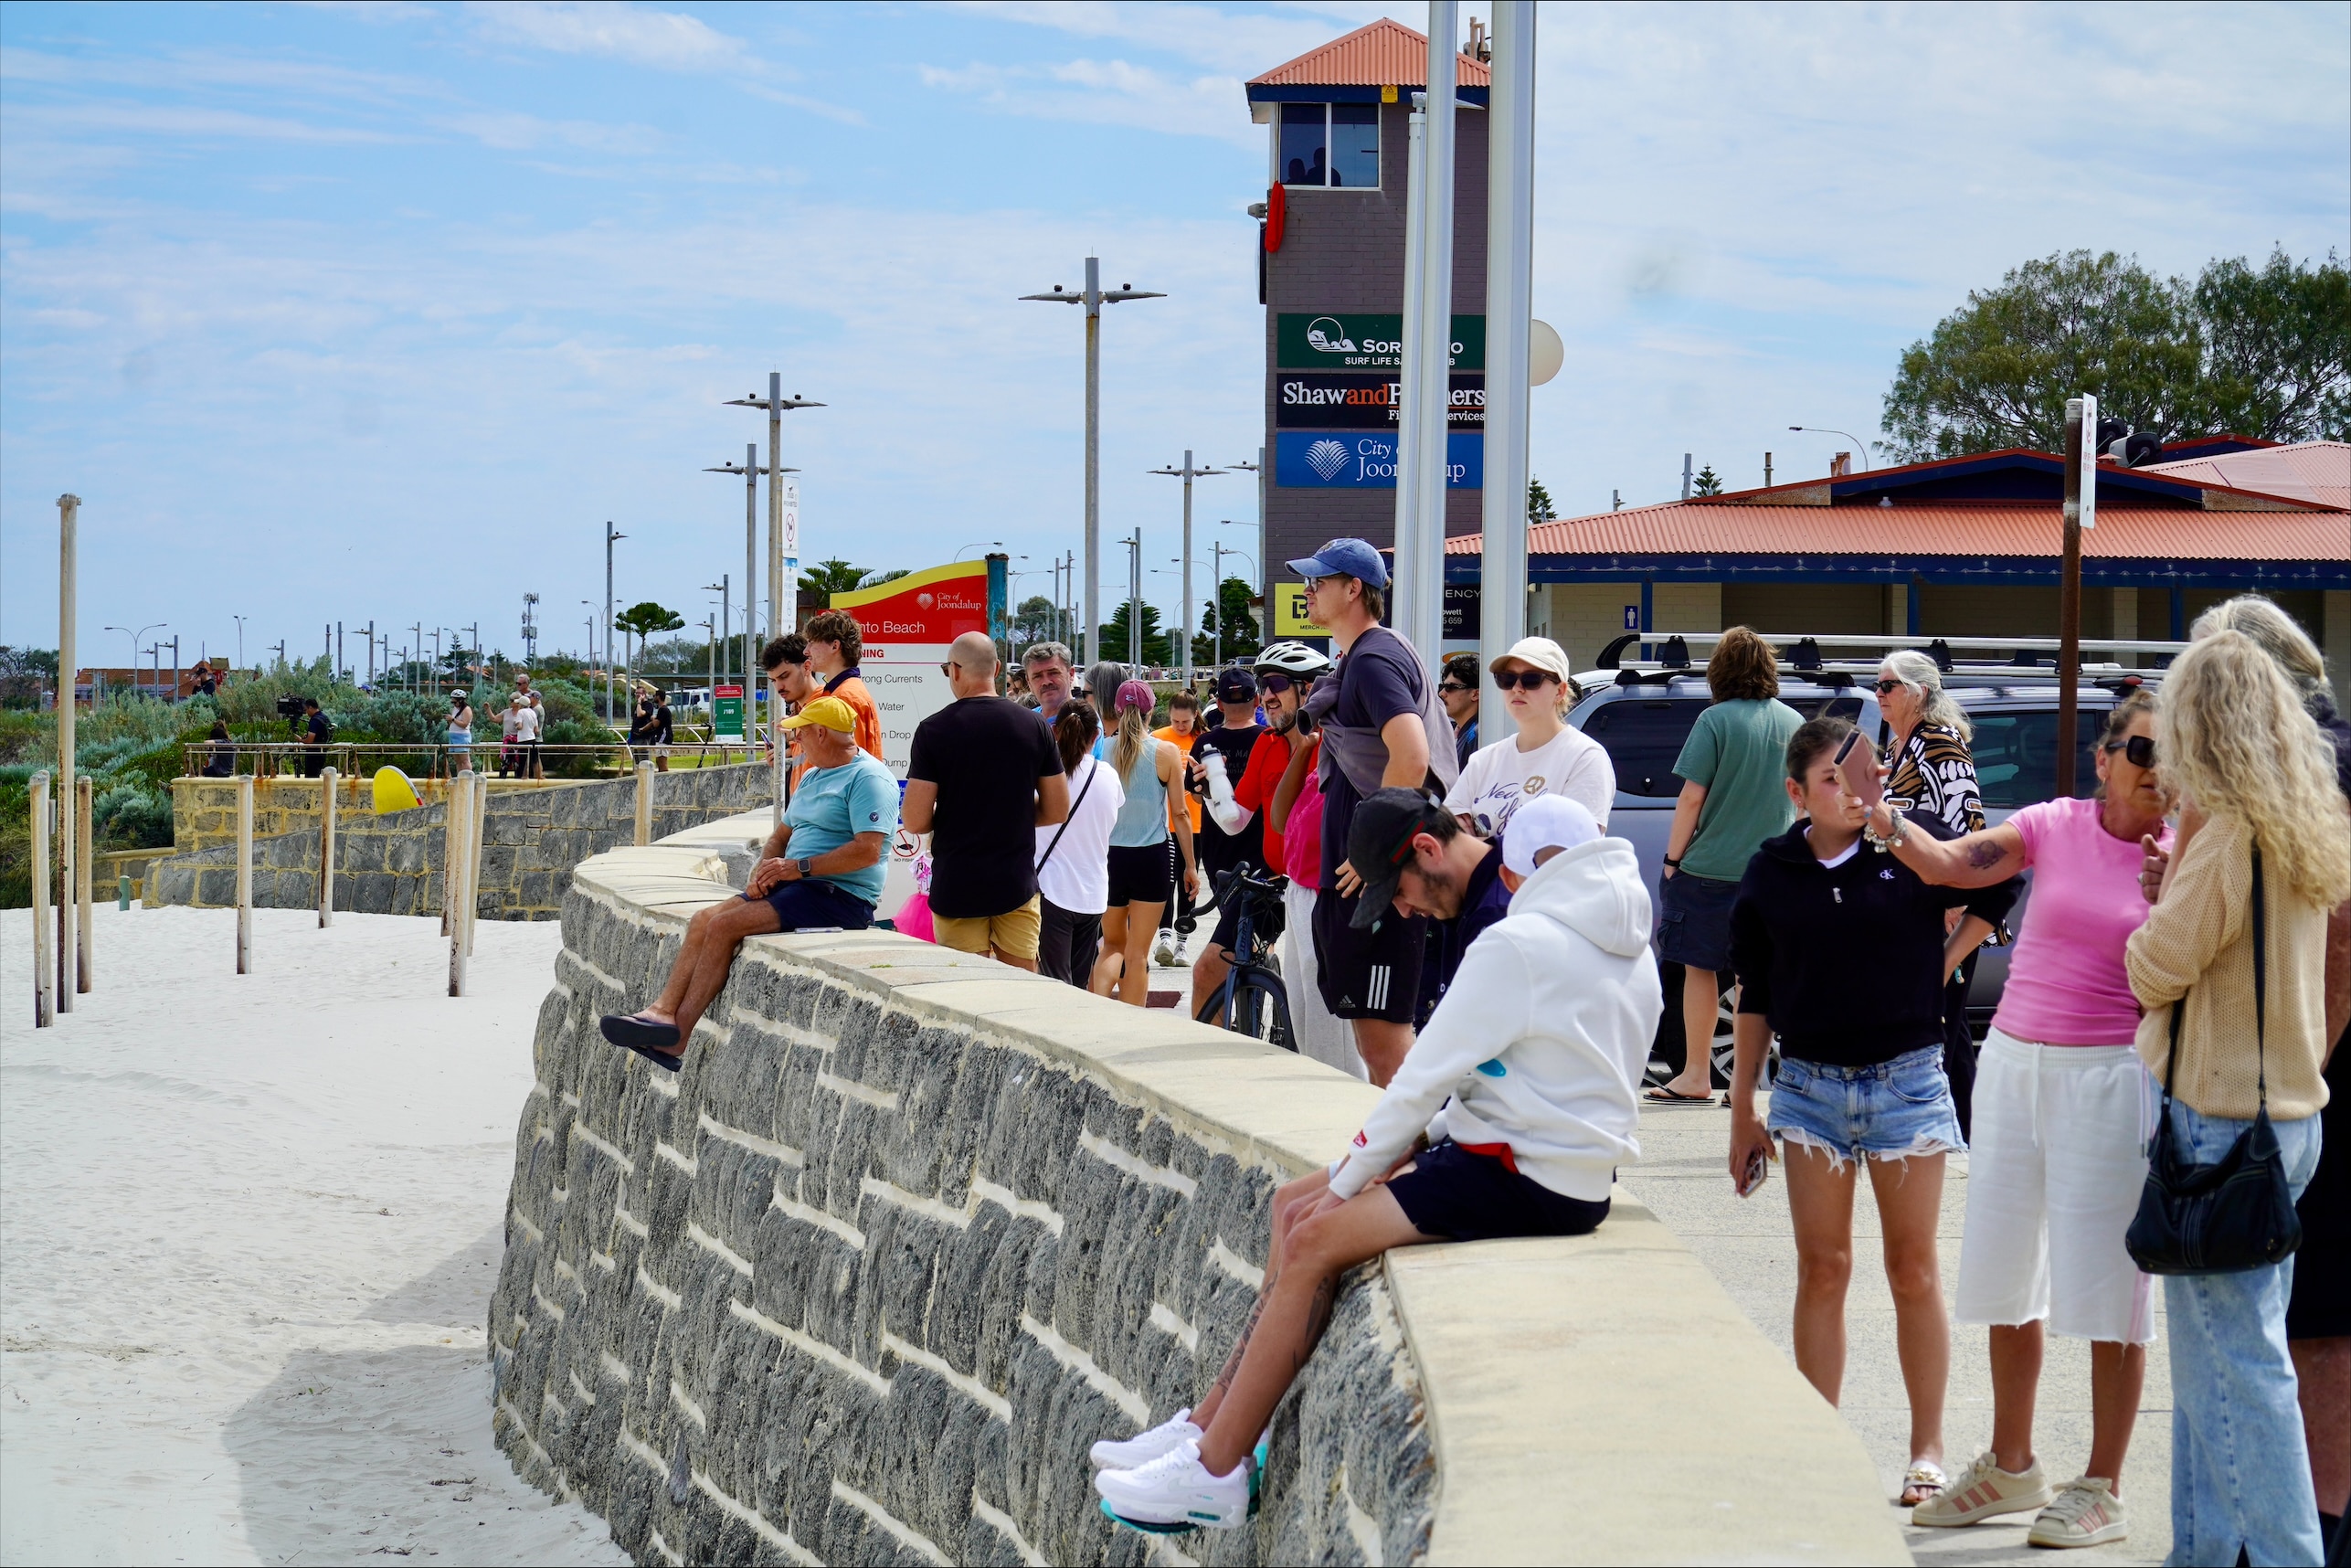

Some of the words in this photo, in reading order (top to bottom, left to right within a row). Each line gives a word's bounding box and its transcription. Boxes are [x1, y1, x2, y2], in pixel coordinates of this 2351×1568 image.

[1344, 356, 1370, 366] SURF
[1371, 356, 1392, 366] LIFE
[1447, 410, 1485, 420] ervices
[1358, 439, 1392, 460] City
[937, 592, 951, 601] City
[952, 592, 960, 601] of
[1445, 589, 1481, 598] ENCY
[937, 599, 982, 611] Joondalup
[883, 620, 926, 633] Beach
[862, 649, 884, 658] NING
[863, 675, 882, 684] rong
[884, 674, 923, 683] Currents
[878, 703, 905, 711] Water
[889, 731, 912, 741] Drop
